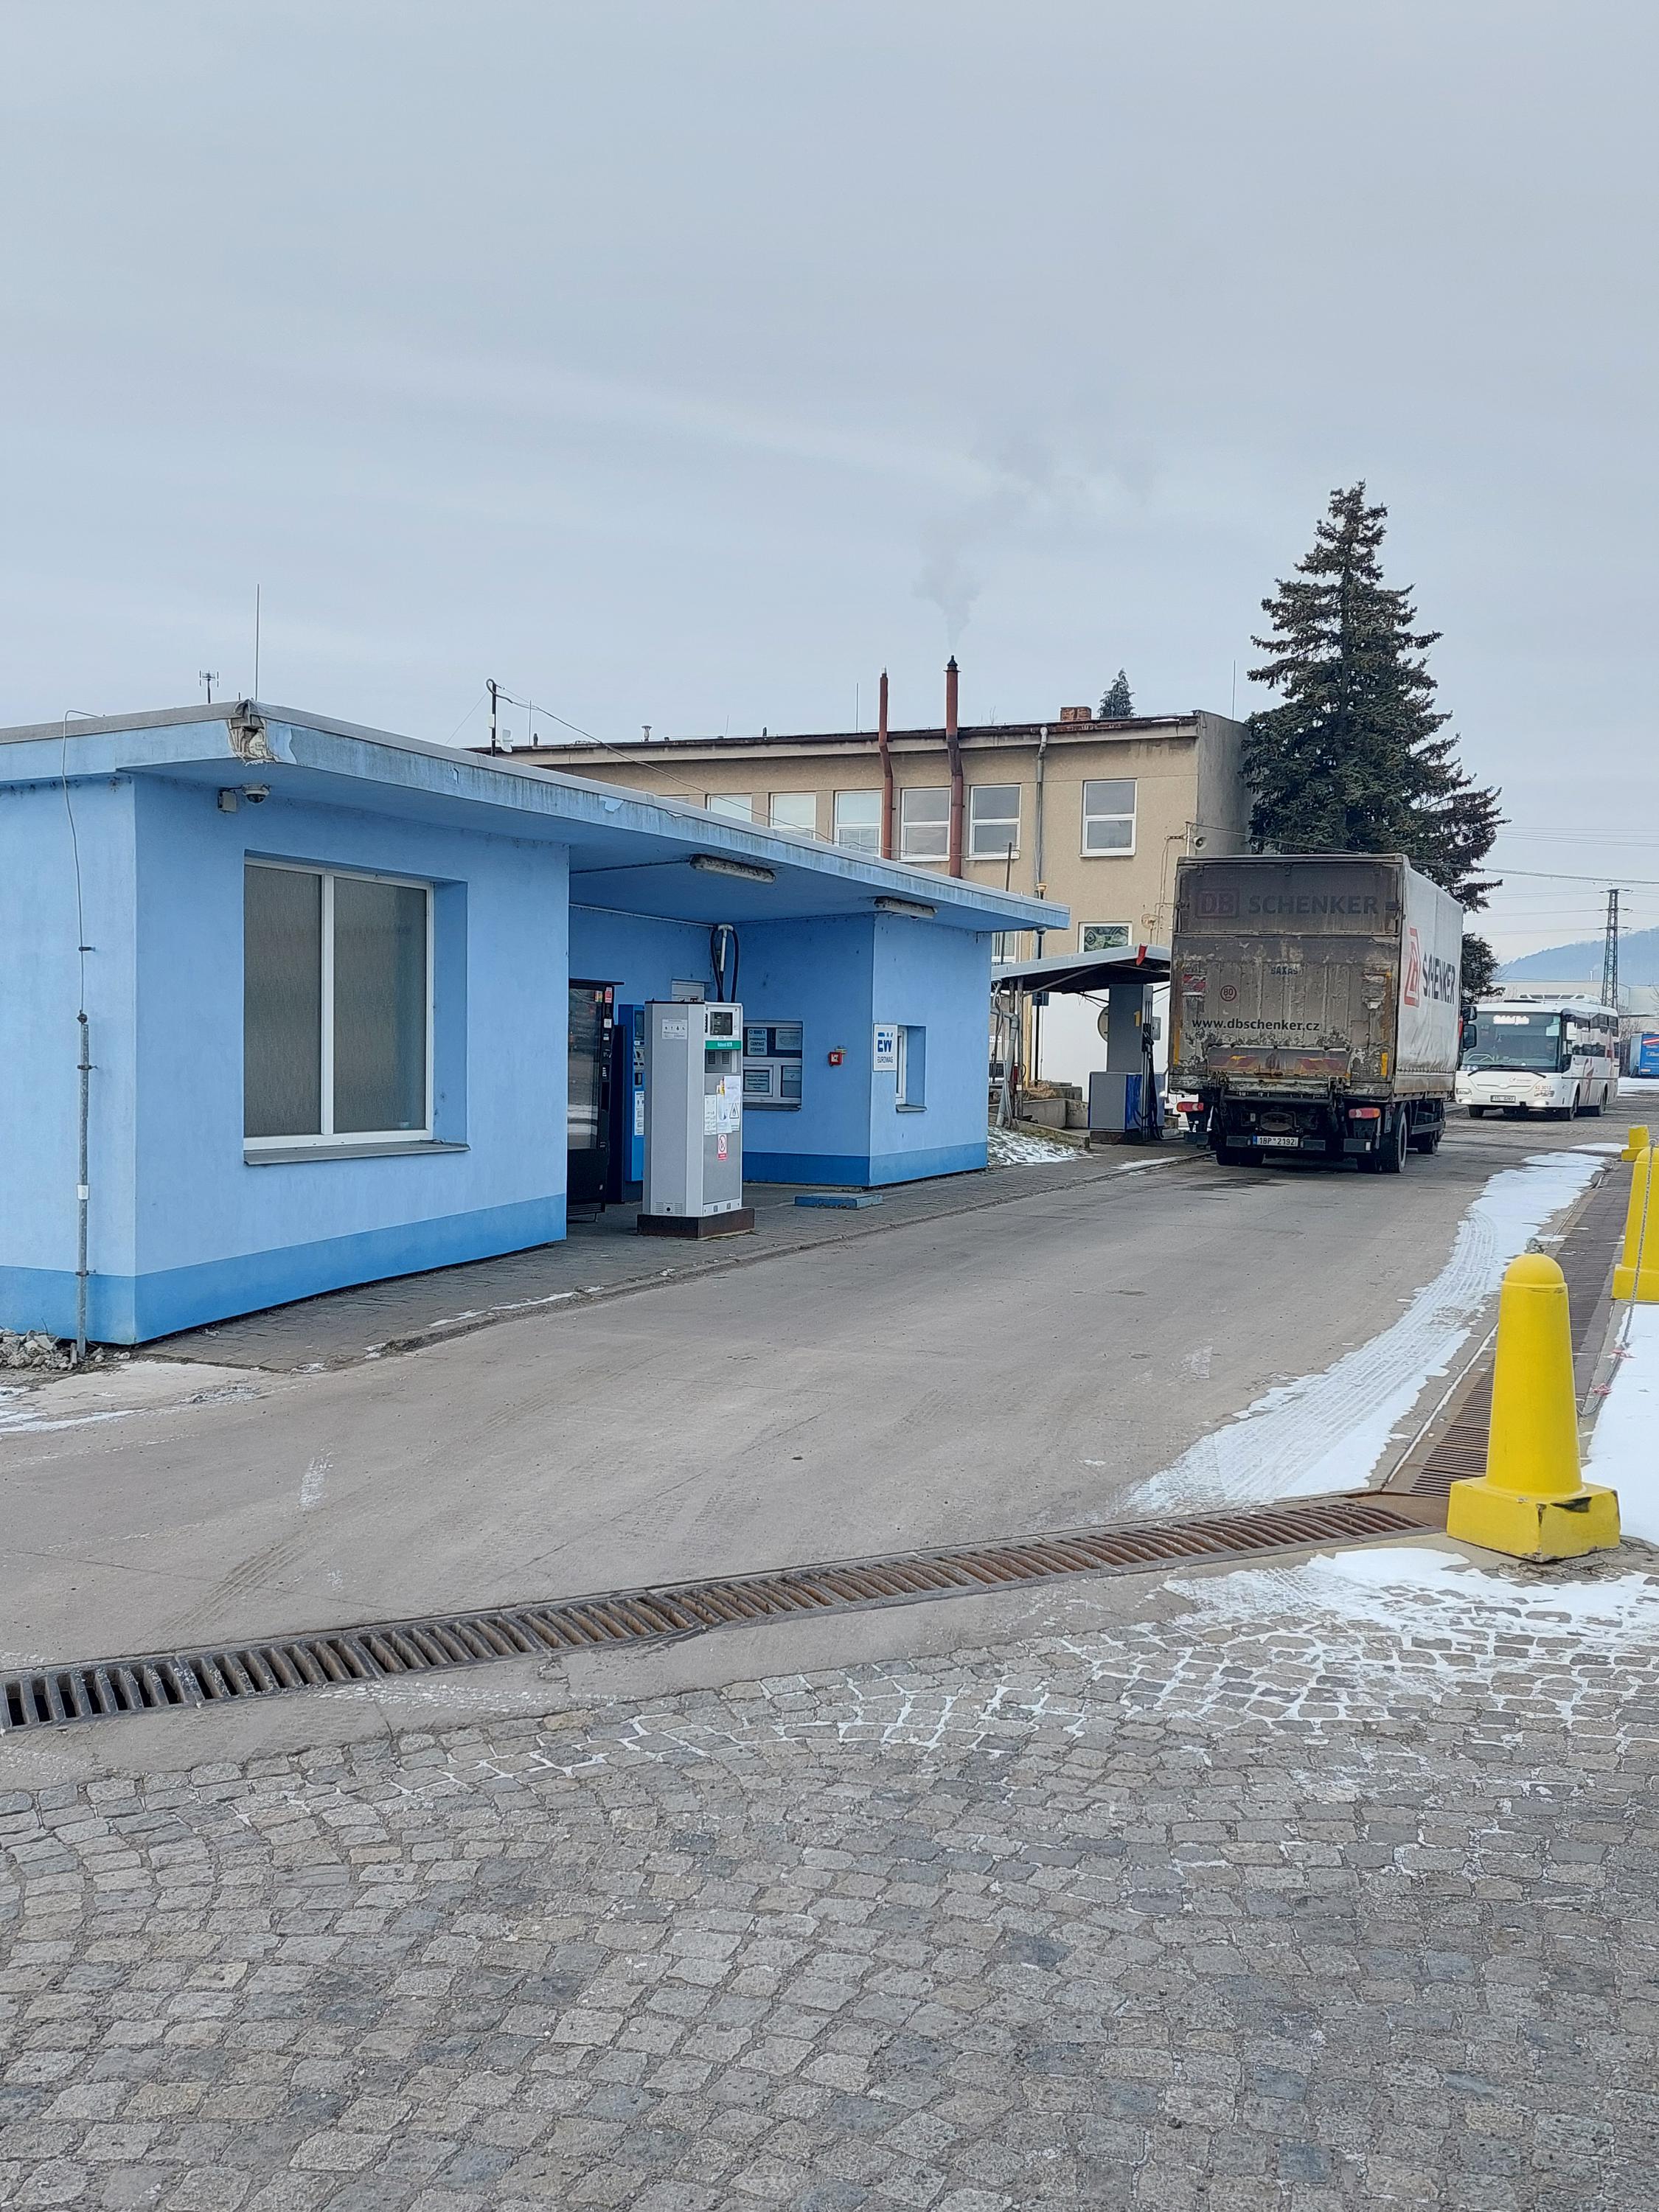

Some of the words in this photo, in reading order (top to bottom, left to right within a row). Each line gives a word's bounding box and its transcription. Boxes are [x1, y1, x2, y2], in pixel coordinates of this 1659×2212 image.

[1200, 891, 1235, 914] DB
[1248, 894, 1378, 914] SCHENKER
[1222, 988, 1234, 996] 80
[1192, 1018, 1320, 1031] www.dbschenker.cz
[1277, 1138, 1295, 1146] 2192
